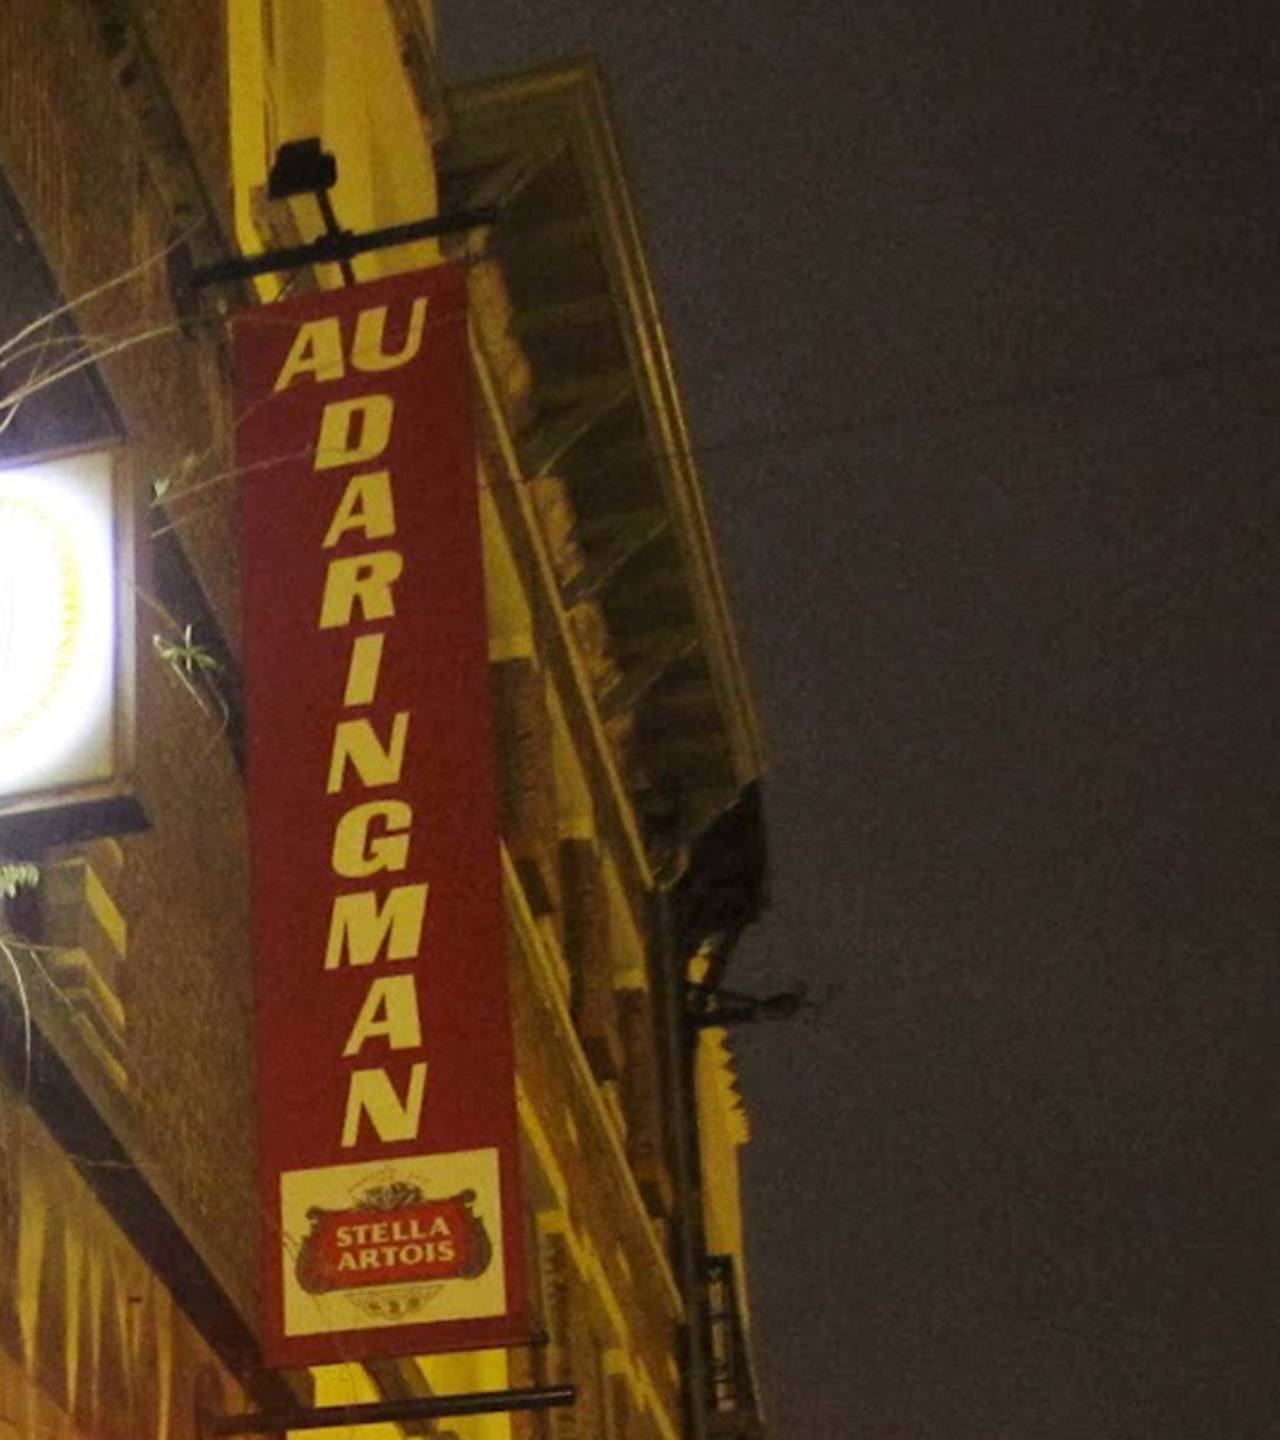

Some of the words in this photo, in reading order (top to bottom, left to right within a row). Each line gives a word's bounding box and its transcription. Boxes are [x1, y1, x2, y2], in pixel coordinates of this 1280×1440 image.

[272, 296, 429, 394] AU
[313, 394, 429, 1149] DARINGMAN
[335, 1216, 452, 1248] STELLA
[337, 1241, 456, 1271] ARTOIS
